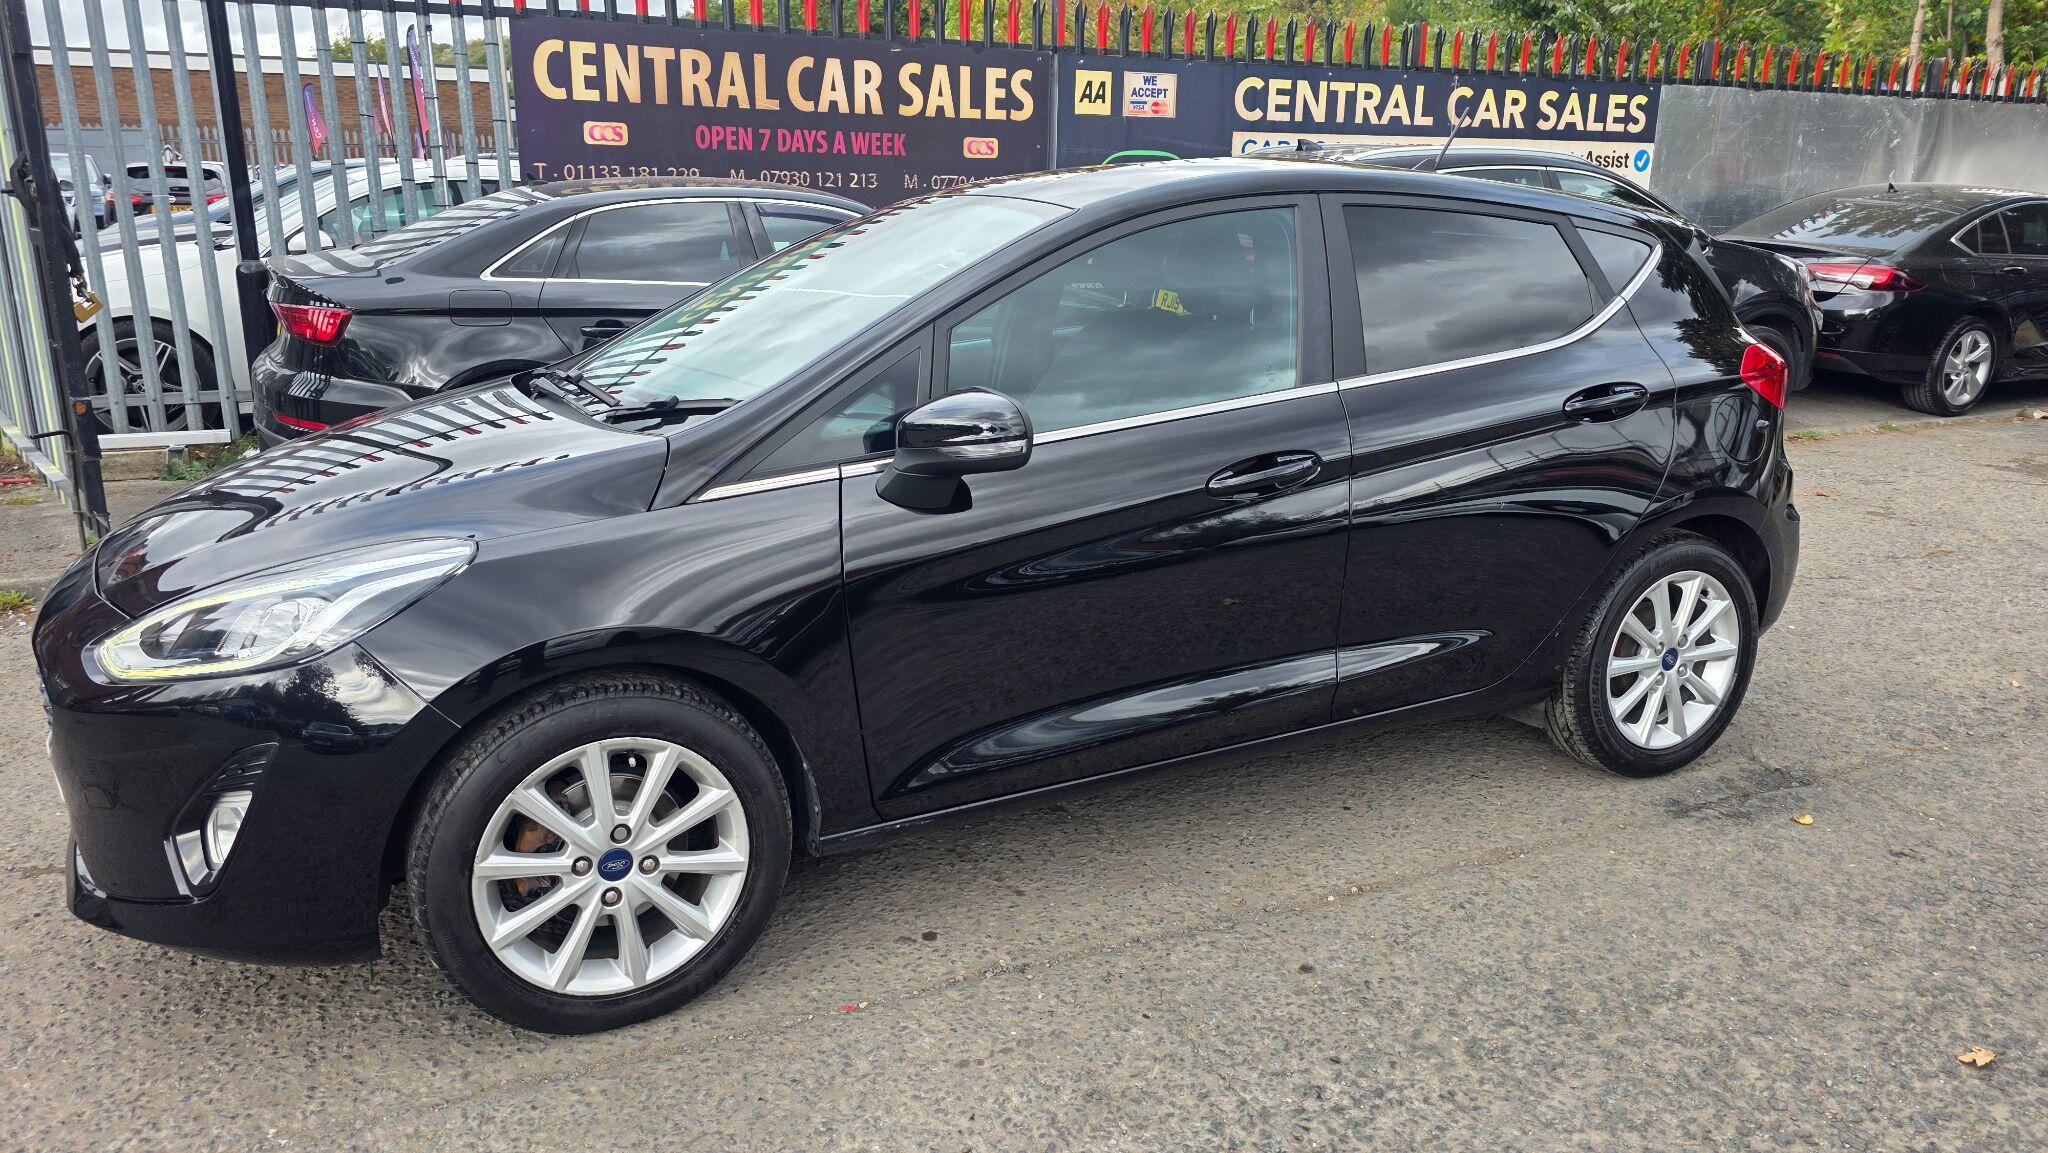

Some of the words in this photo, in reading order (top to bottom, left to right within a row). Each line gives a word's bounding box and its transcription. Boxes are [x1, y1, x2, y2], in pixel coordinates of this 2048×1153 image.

[533, 39, 780, 111] CENTRAL
[786, 55, 884, 115] CAR
[898, 62, 1034, 121] SALES
[1143, 75, 1158, 86] WE
[1079, 80, 1106, 104] AA
[1131, 87, 1169, 99] ACCEPT
[1234, 76, 1434, 126] CENTRAL
[1446, 86, 1525, 129] CAR
[1535, 90, 1649, 134] SALES
[588, 124, 624, 143] CCS
[695, 124, 753, 151] OPEN
[758, 128, 772, 152] 7
[777, 128, 828, 154] DAYS
[832, 130, 847, 155] A
[850, 130, 907, 157] WEEK
[1586, 149, 1630, 169] Assist
[563, 163, 621, 180] 01133
[816, 171, 842, 188] 121
[850, 172, 878, 189] 213
